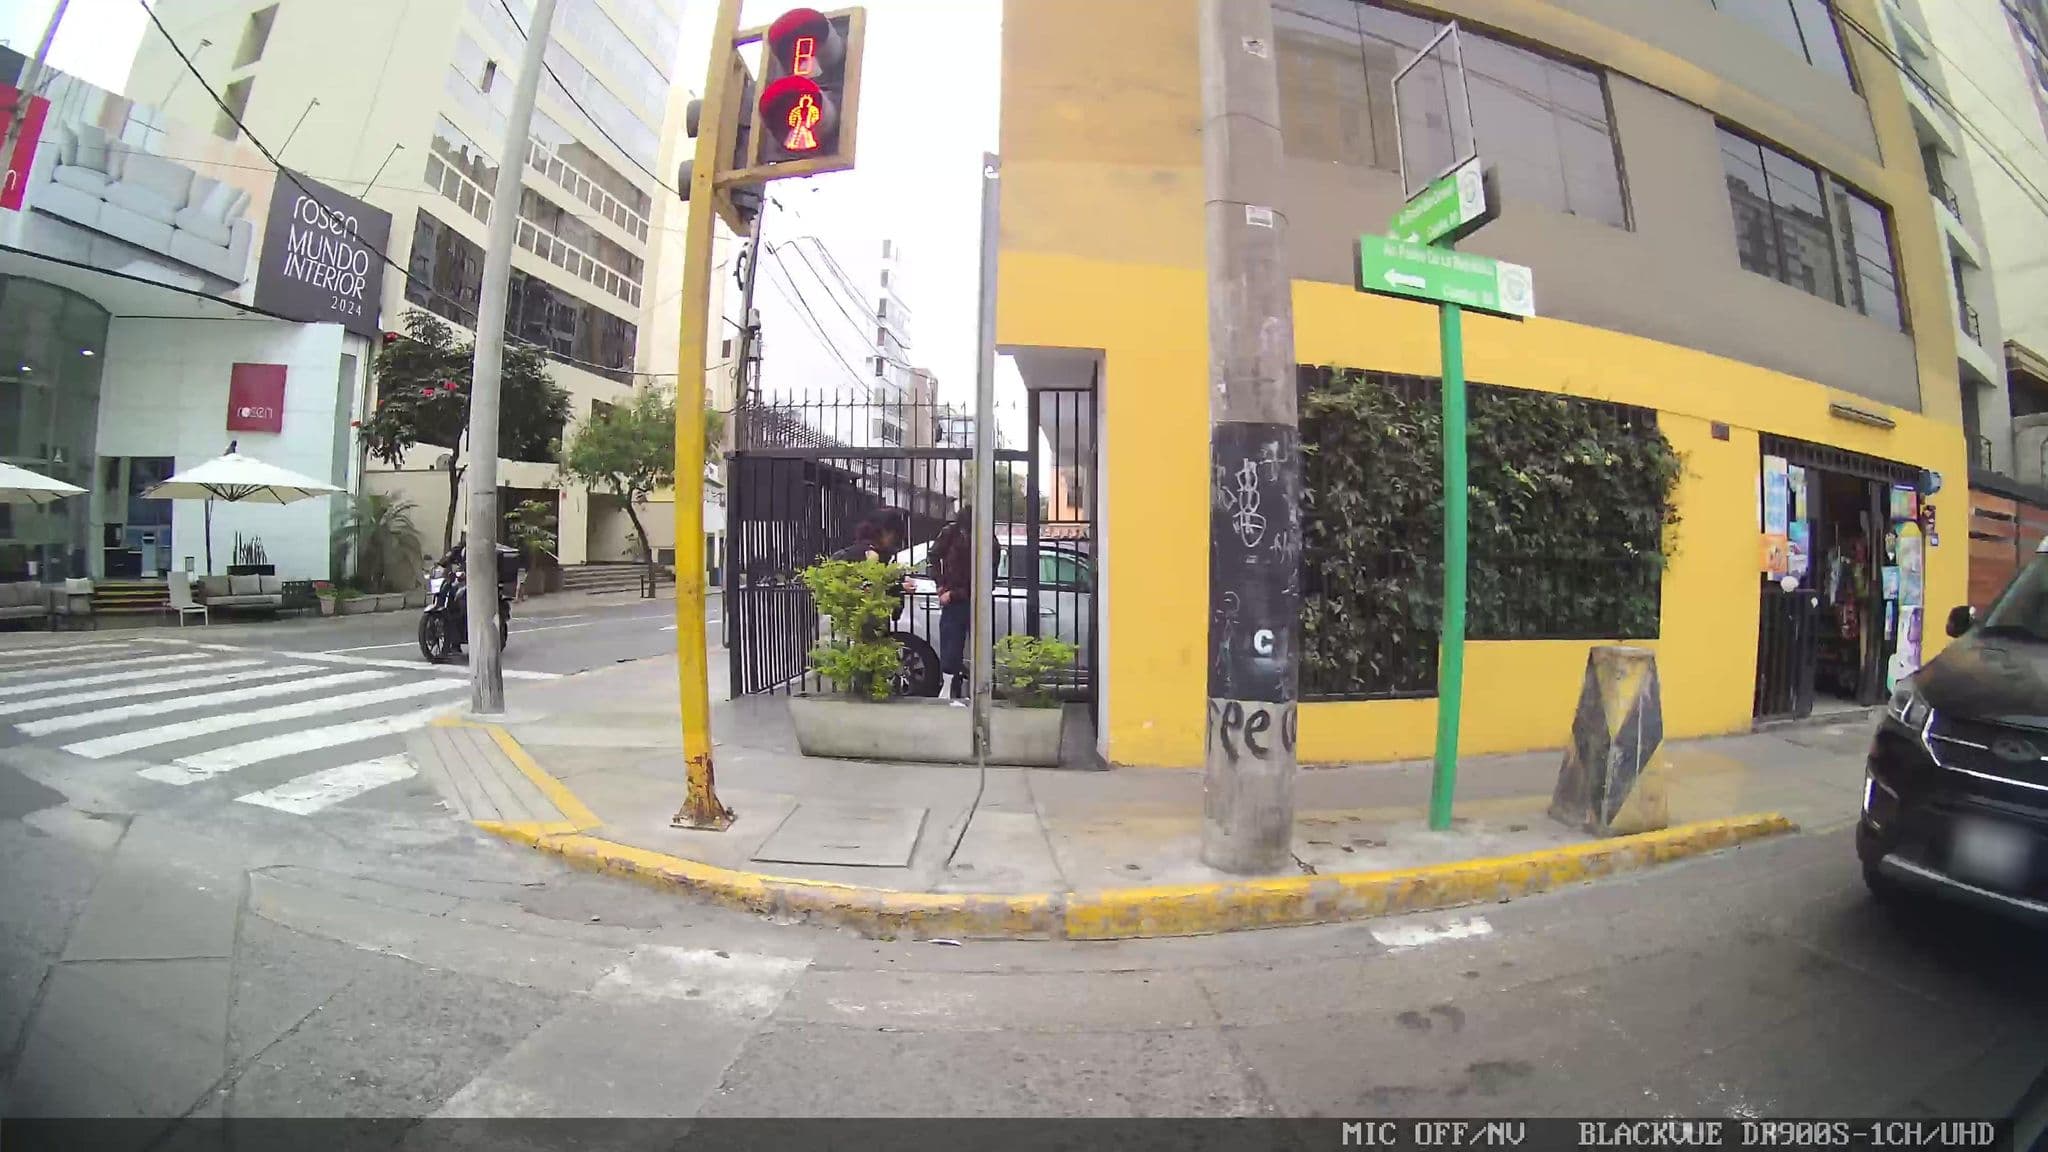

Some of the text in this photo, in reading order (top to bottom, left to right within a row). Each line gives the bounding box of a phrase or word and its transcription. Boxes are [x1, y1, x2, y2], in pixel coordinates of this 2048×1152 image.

[293, 196, 358, 242] rosen
[287, 223, 369, 277] MUNDO
[283, 252, 366, 300] INTERIOR
[330, 295, 362, 316] 2024
